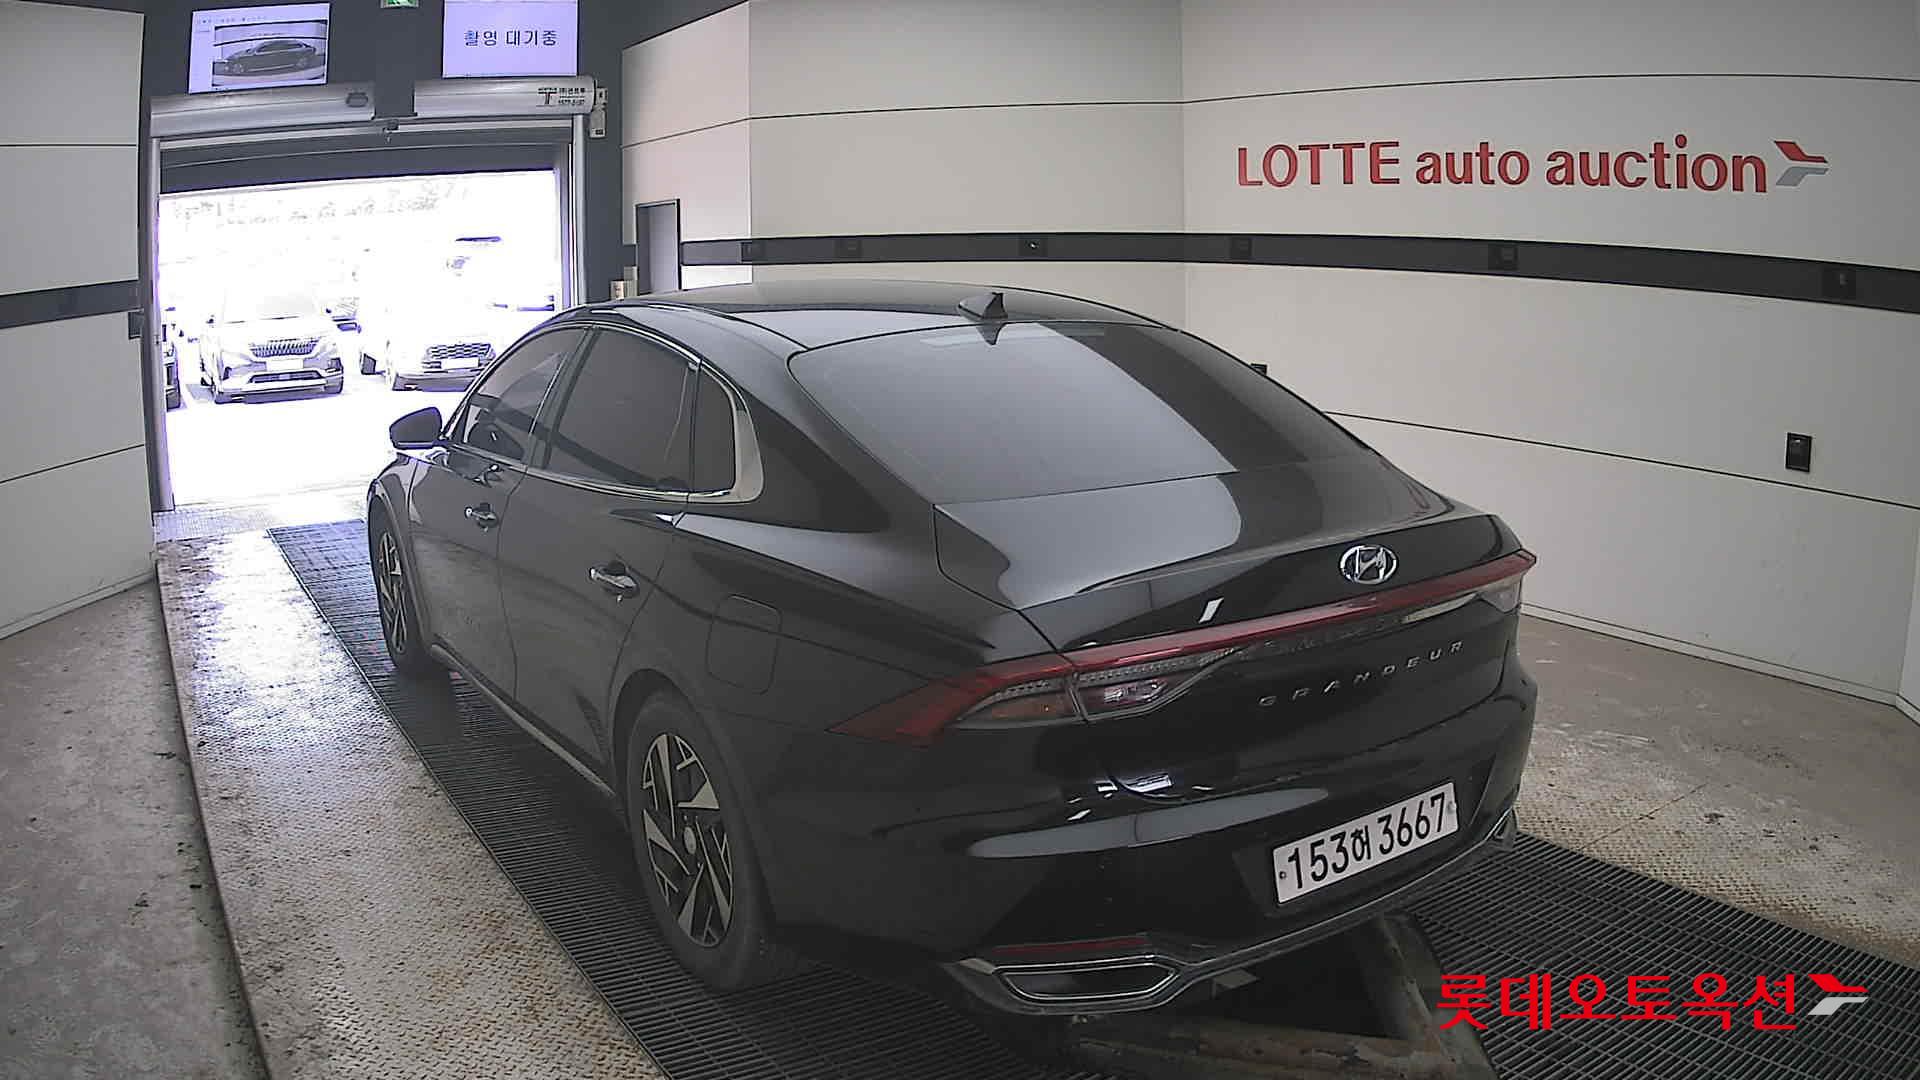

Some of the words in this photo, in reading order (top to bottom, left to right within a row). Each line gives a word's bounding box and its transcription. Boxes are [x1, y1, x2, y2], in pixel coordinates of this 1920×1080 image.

[464, 29, 498, 47] 촬영
[506, 29, 558, 47] 대기중
[1238, 141, 1401, 188] LOTTE
[1415, 142, 1530, 187] auto
[1546, 134, 1767, 193] auction
[1258, 640, 1464, 707] GRANDEUR
